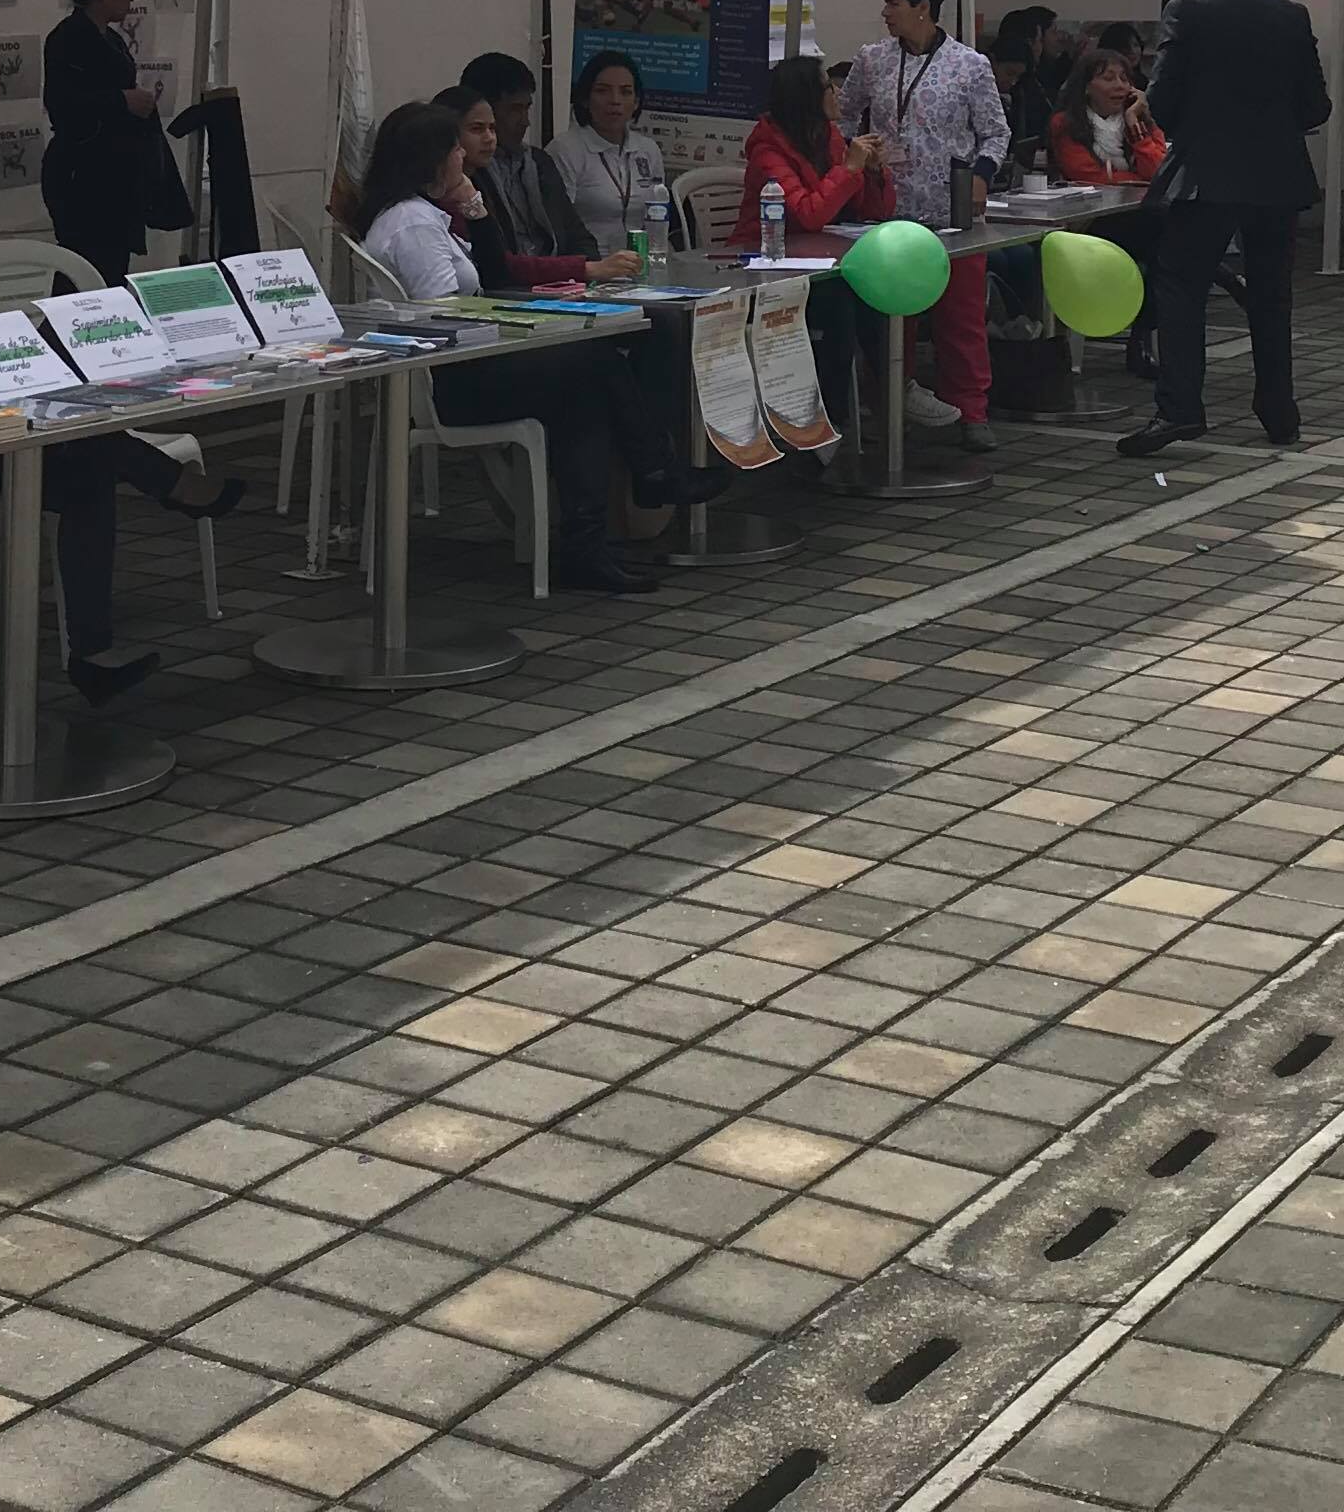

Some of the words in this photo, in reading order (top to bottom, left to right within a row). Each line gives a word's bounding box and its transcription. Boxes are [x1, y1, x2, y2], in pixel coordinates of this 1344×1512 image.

[649, 113, 688, 124] CONVENIOS
[134, 324, 154, 338] Paz
[7, 337, 17, 348] de
[18, 335, 41, 346] Paz
